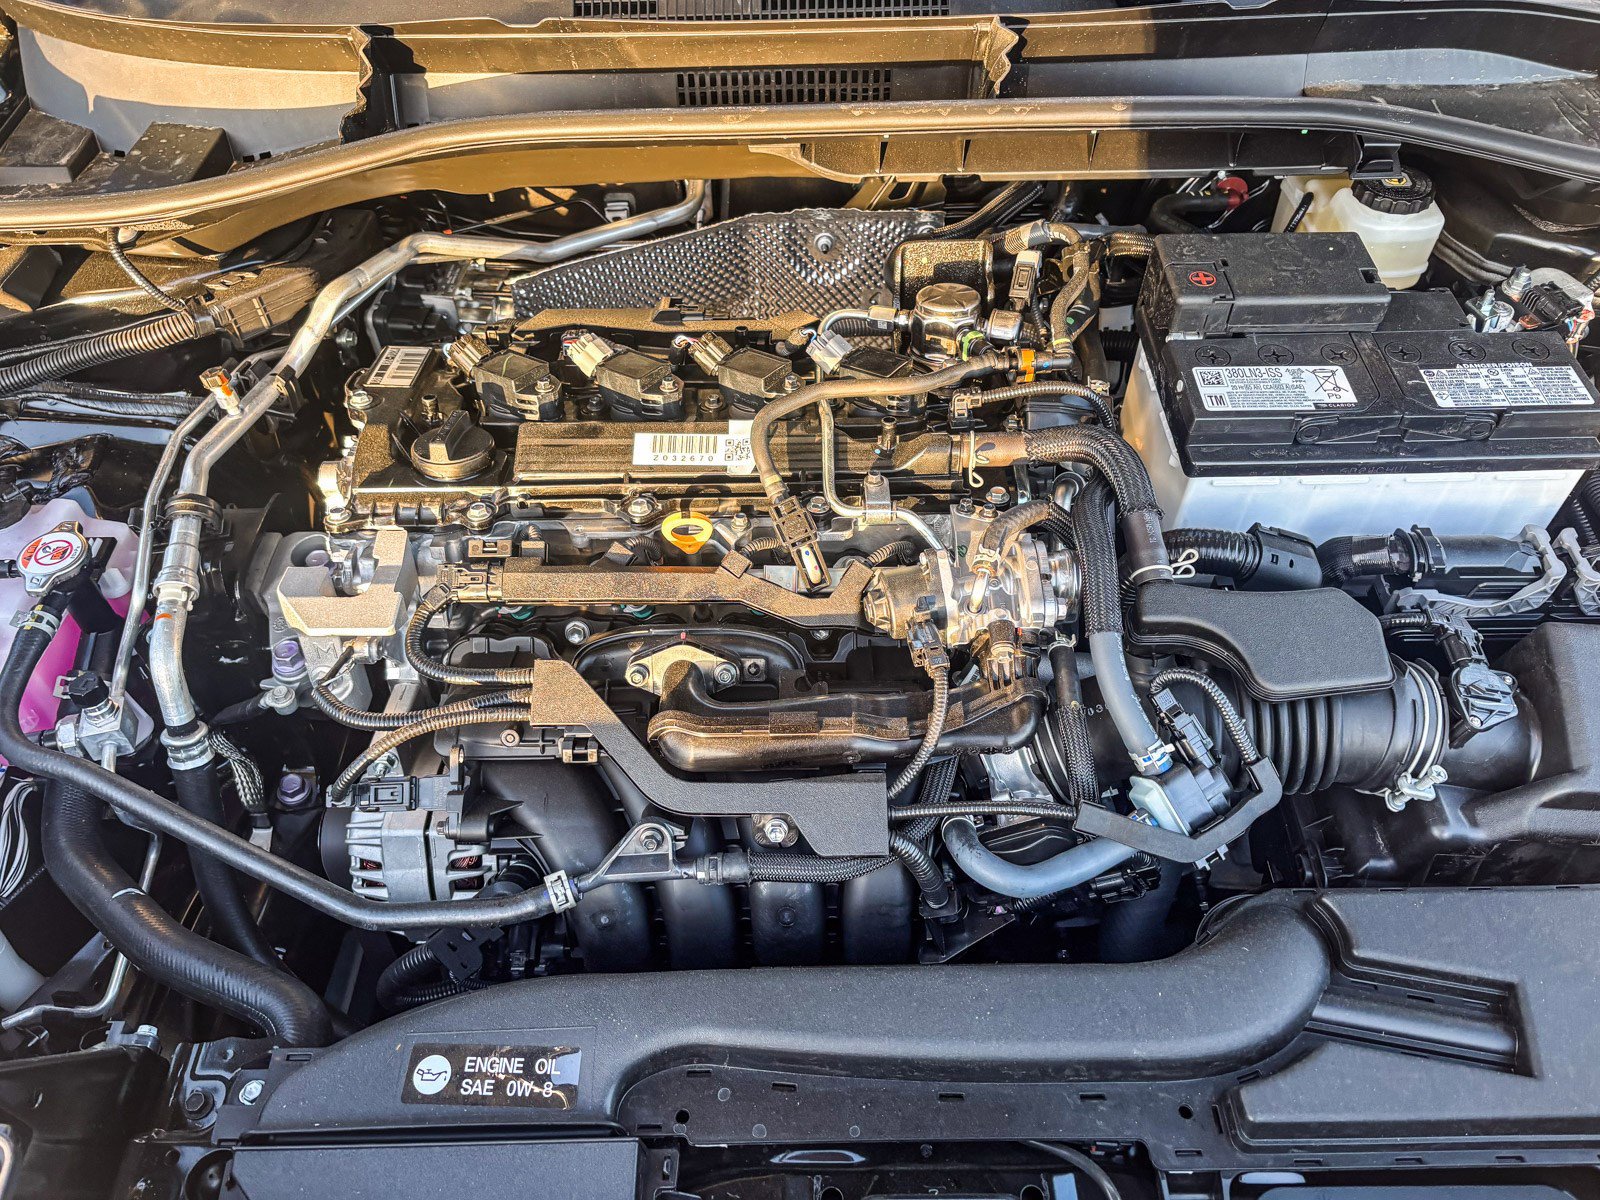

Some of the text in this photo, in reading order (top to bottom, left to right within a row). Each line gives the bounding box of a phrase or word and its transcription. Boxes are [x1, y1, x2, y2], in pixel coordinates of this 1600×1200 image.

[1226, 367, 1283, 379] 380LN3-ISS
[1207, 395, 1226, 407] TM
[465, 1057, 561, 1075] ENGINE OIL
[460, 1079, 553, 1098] SAE 0W-8
